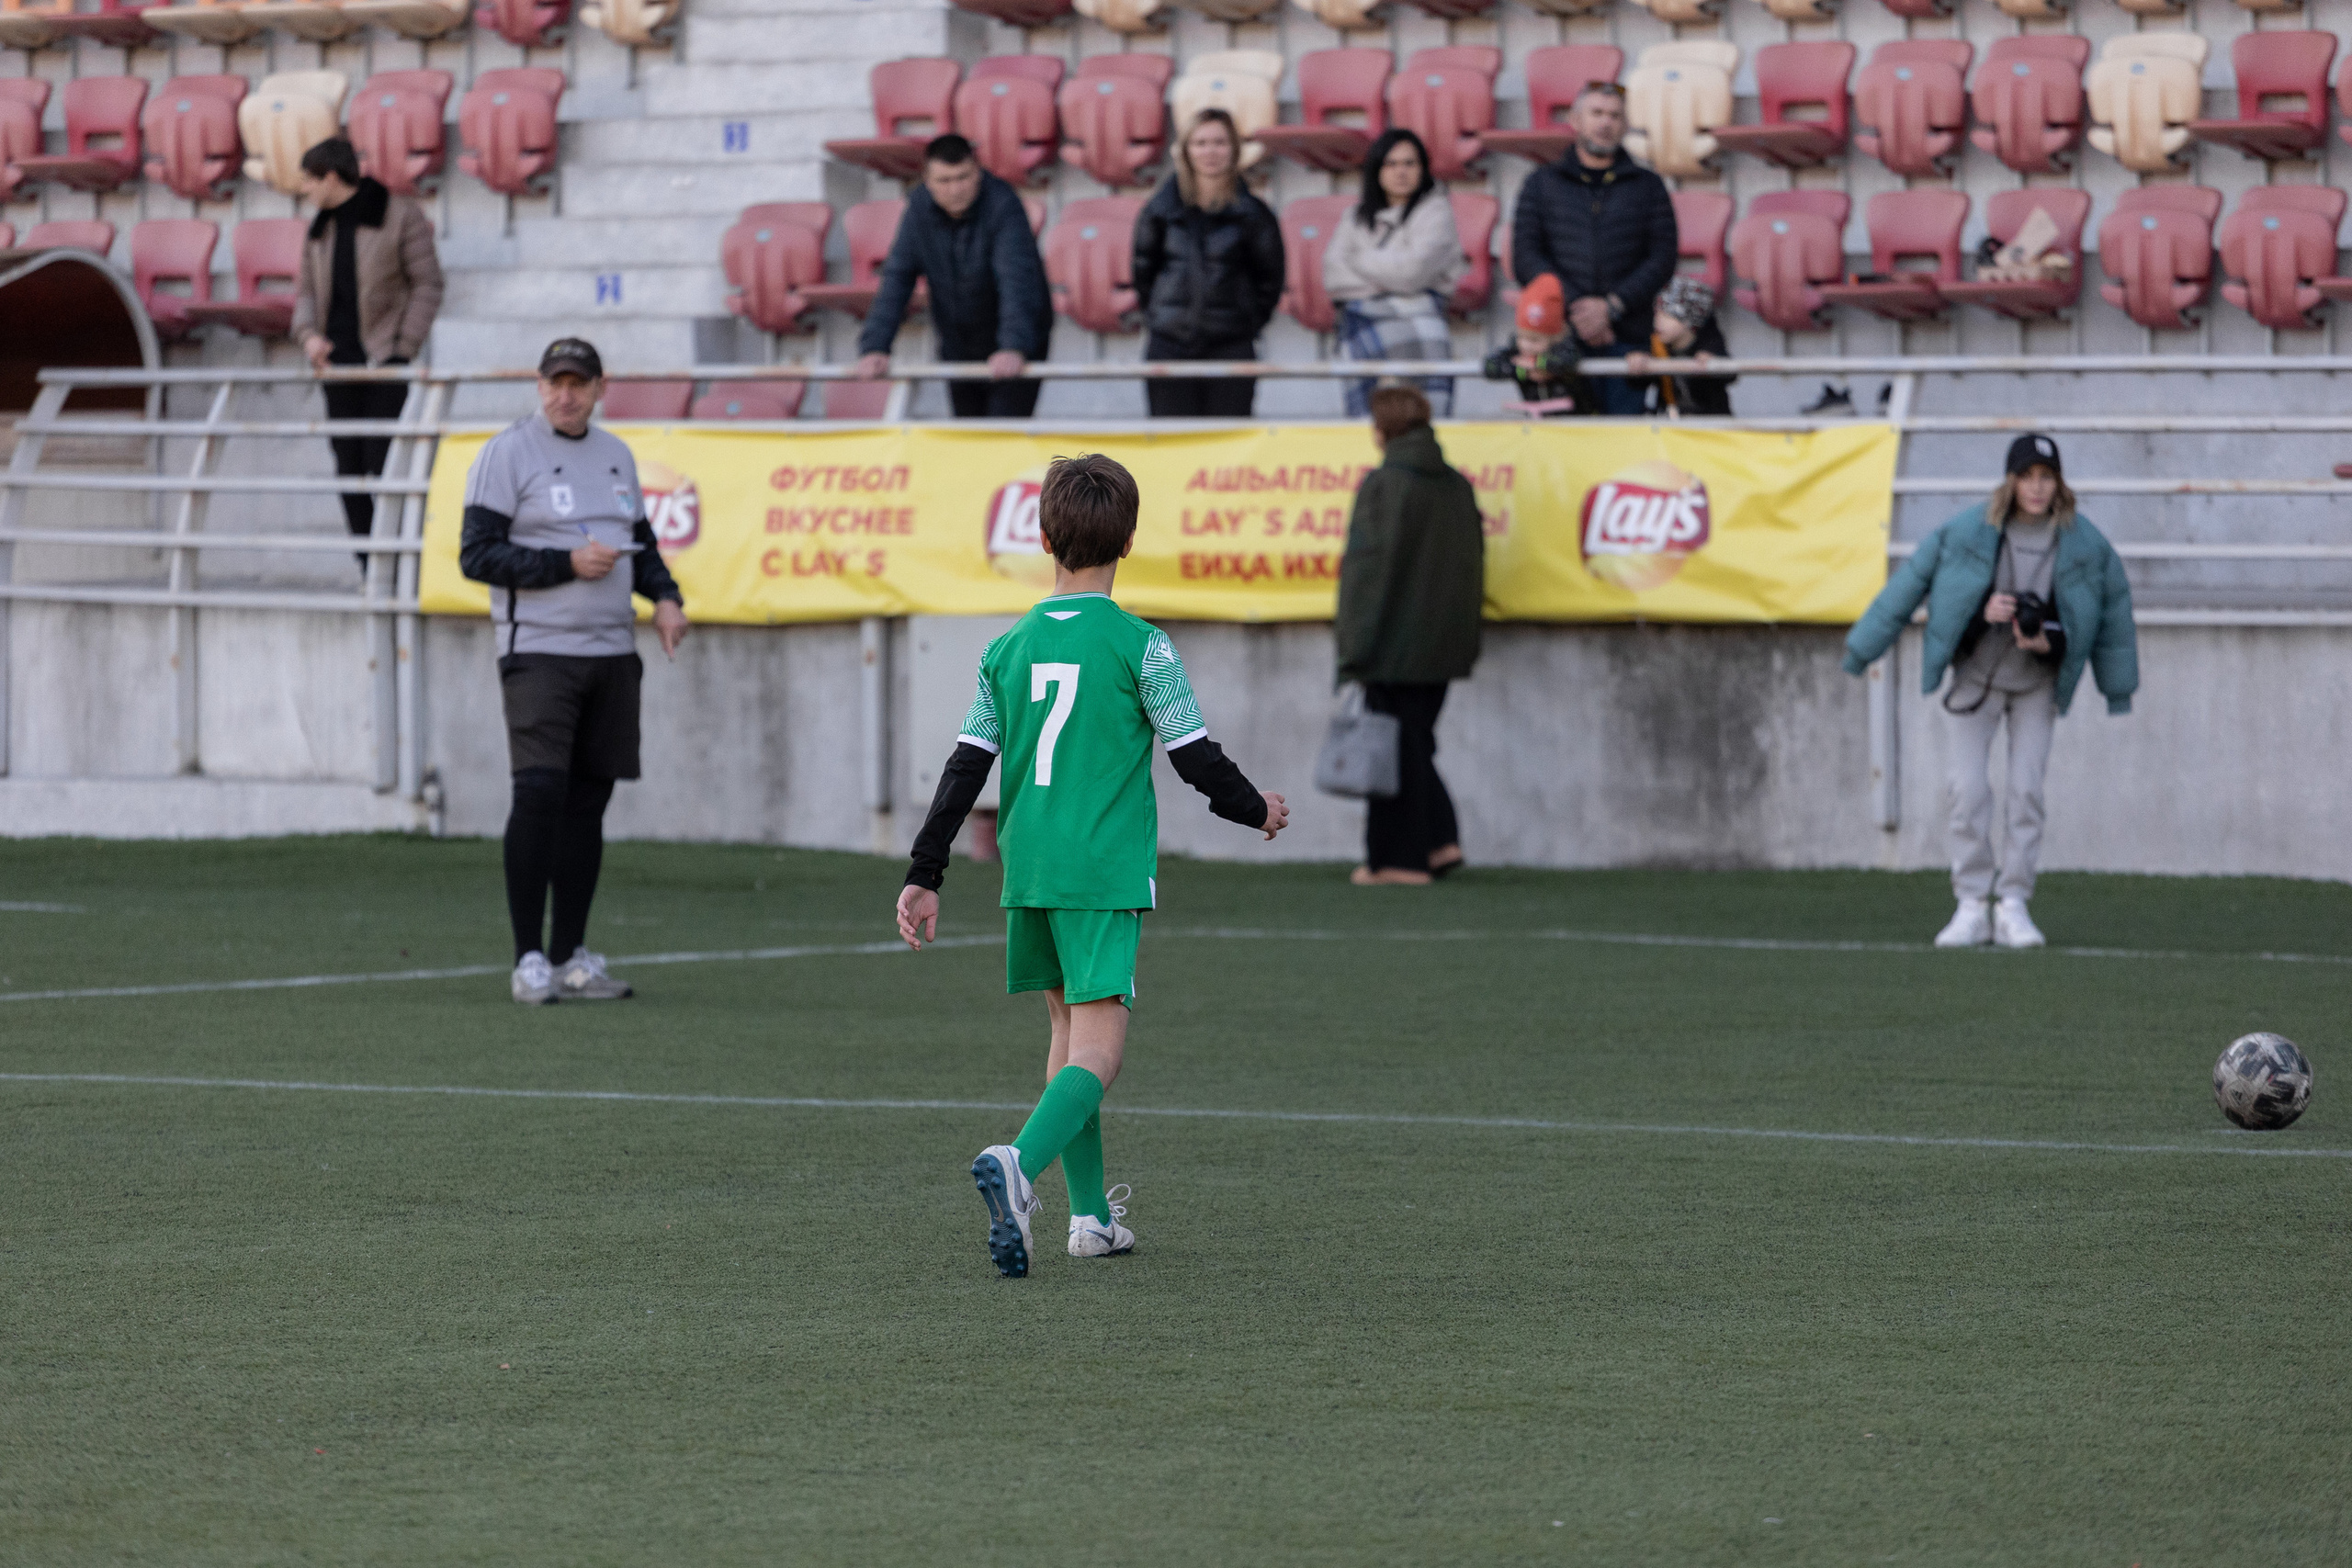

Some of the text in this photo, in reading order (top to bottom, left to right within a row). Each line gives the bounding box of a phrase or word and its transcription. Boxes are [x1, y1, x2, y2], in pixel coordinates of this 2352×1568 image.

[769, 464, 911, 492] ФУТБОЛ
[764, 507, 914, 535] ВКУСНЕЕ
[1584, 484, 1707, 556] Lay's
[1031, 662, 1080, 786] 7
